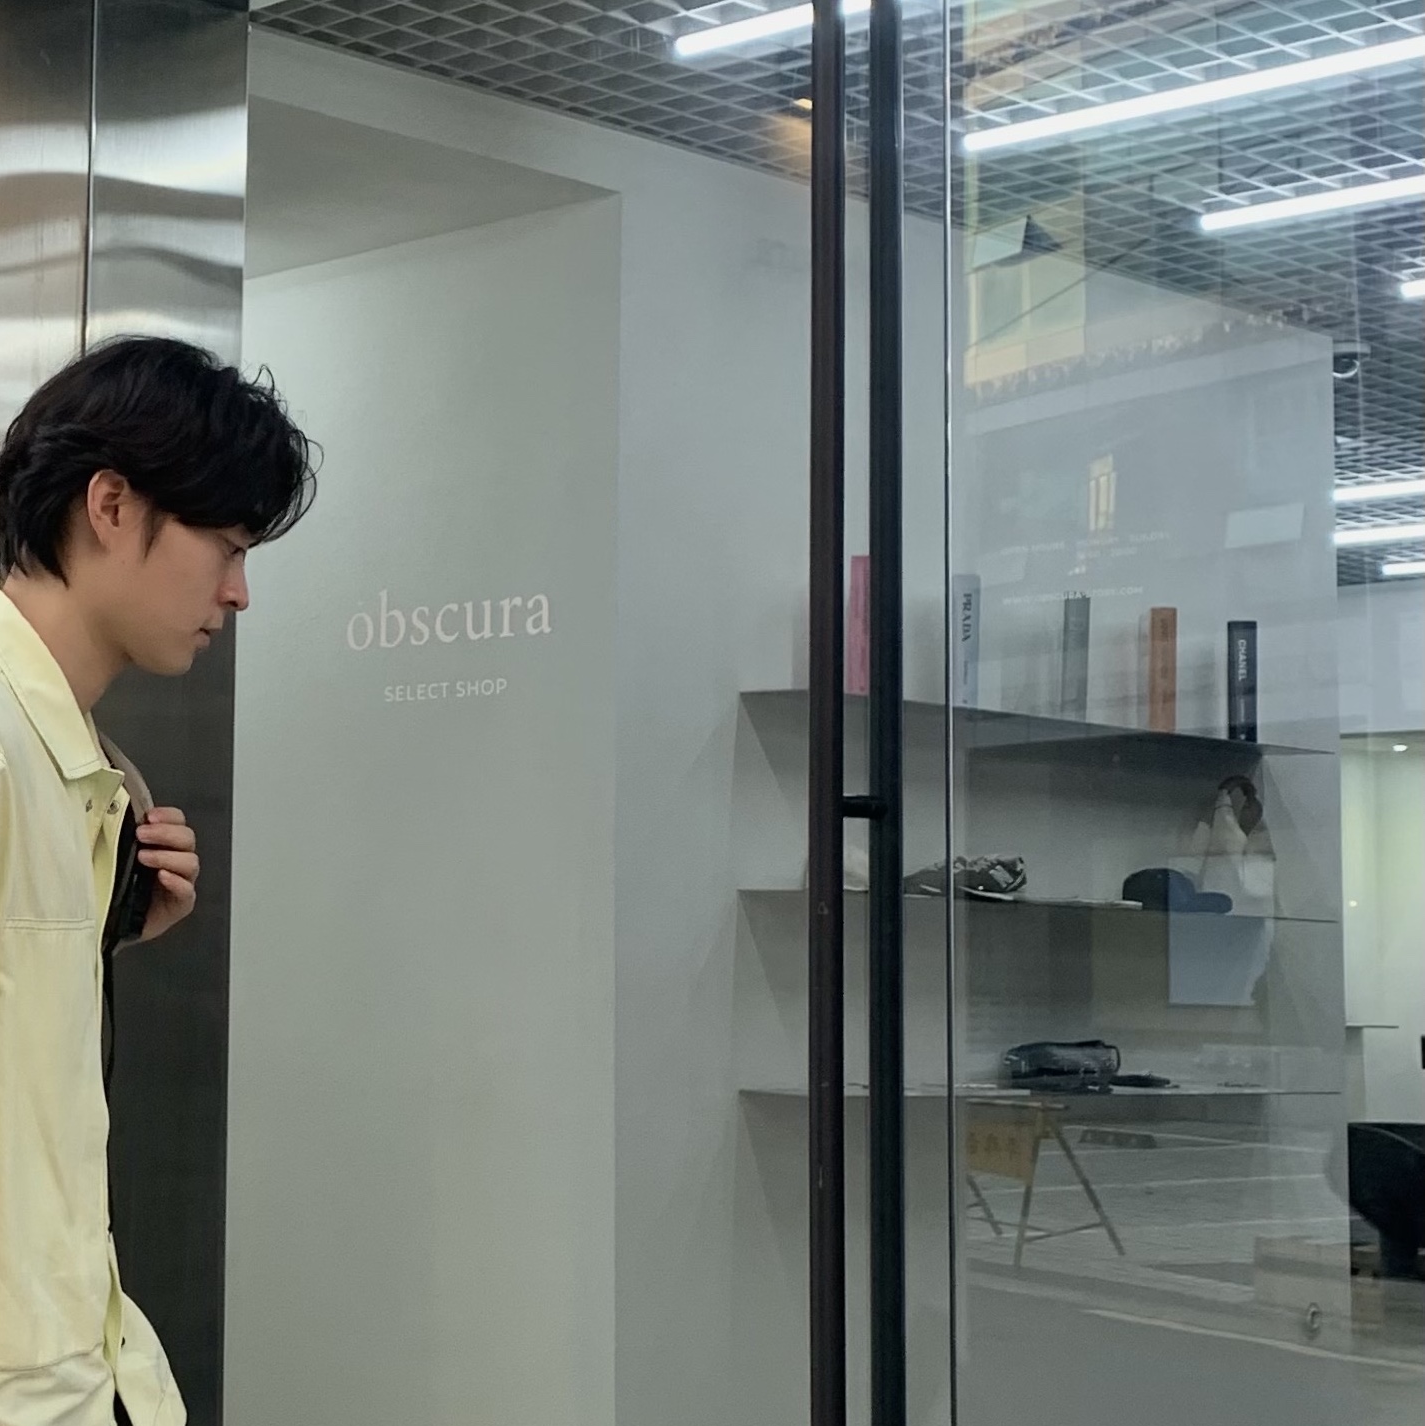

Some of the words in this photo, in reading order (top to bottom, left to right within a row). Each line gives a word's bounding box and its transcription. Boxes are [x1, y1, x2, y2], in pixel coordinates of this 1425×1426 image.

[346, 588, 552, 651] obscura
[962, 593, 972, 642] PRADA
[1238, 639, 1247, 681] CHANEL
[384, 682, 450, 702] SELECT
[455, 677, 508, 698] SHOP
